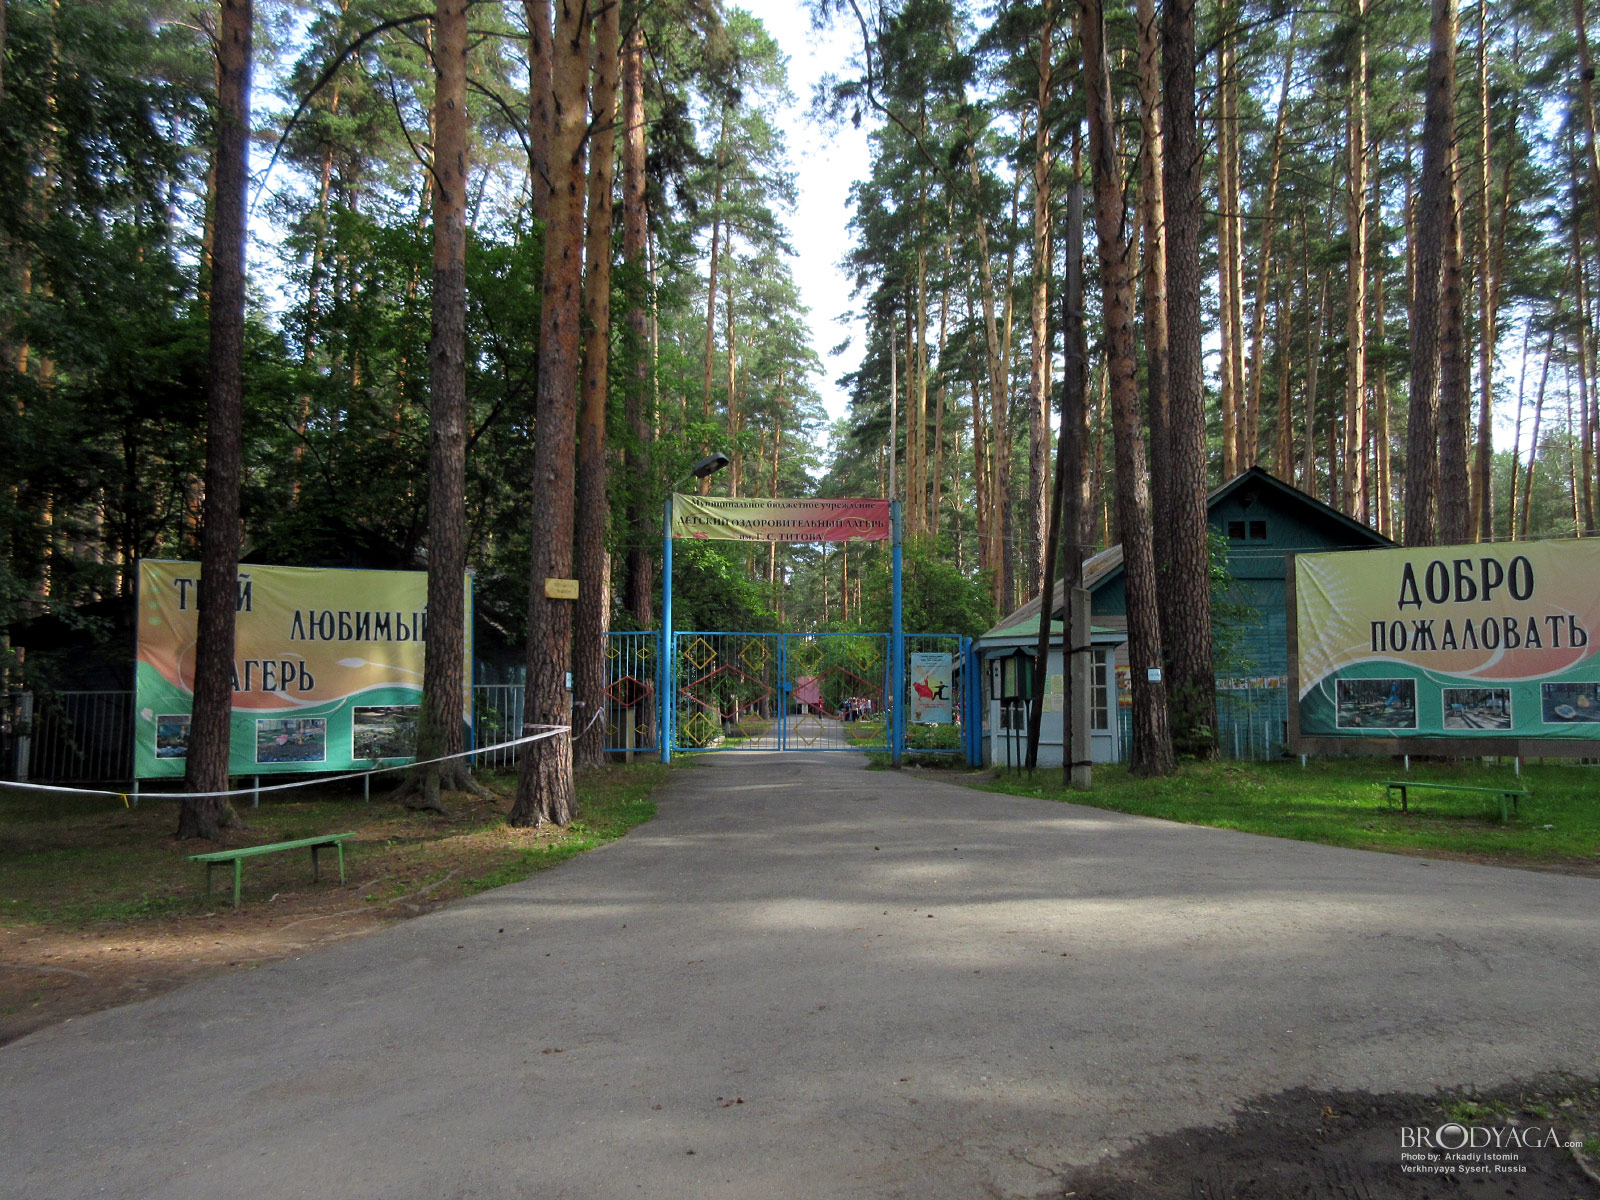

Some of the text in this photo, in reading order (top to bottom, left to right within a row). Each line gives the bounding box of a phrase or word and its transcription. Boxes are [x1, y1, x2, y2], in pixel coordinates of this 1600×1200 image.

[691, 499, 765, 508] Муниципальное
[767, 501, 818, 509] бюджетное
[677, 516, 884, 528] ДЕТСКИЙ ОЗДОРОВИТЕЛЬНЫЙ ЛАГЕРЬ
[779, 533, 823, 541] ТИТОВА
[174, 573, 252, 612] ТЙ
[1398, 556, 1534, 610] ДОБРО
[1371, 615, 1587, 651] ПОЖАЛОВАТЬ
[232, 660, 315, 692] АГЕРЬ
